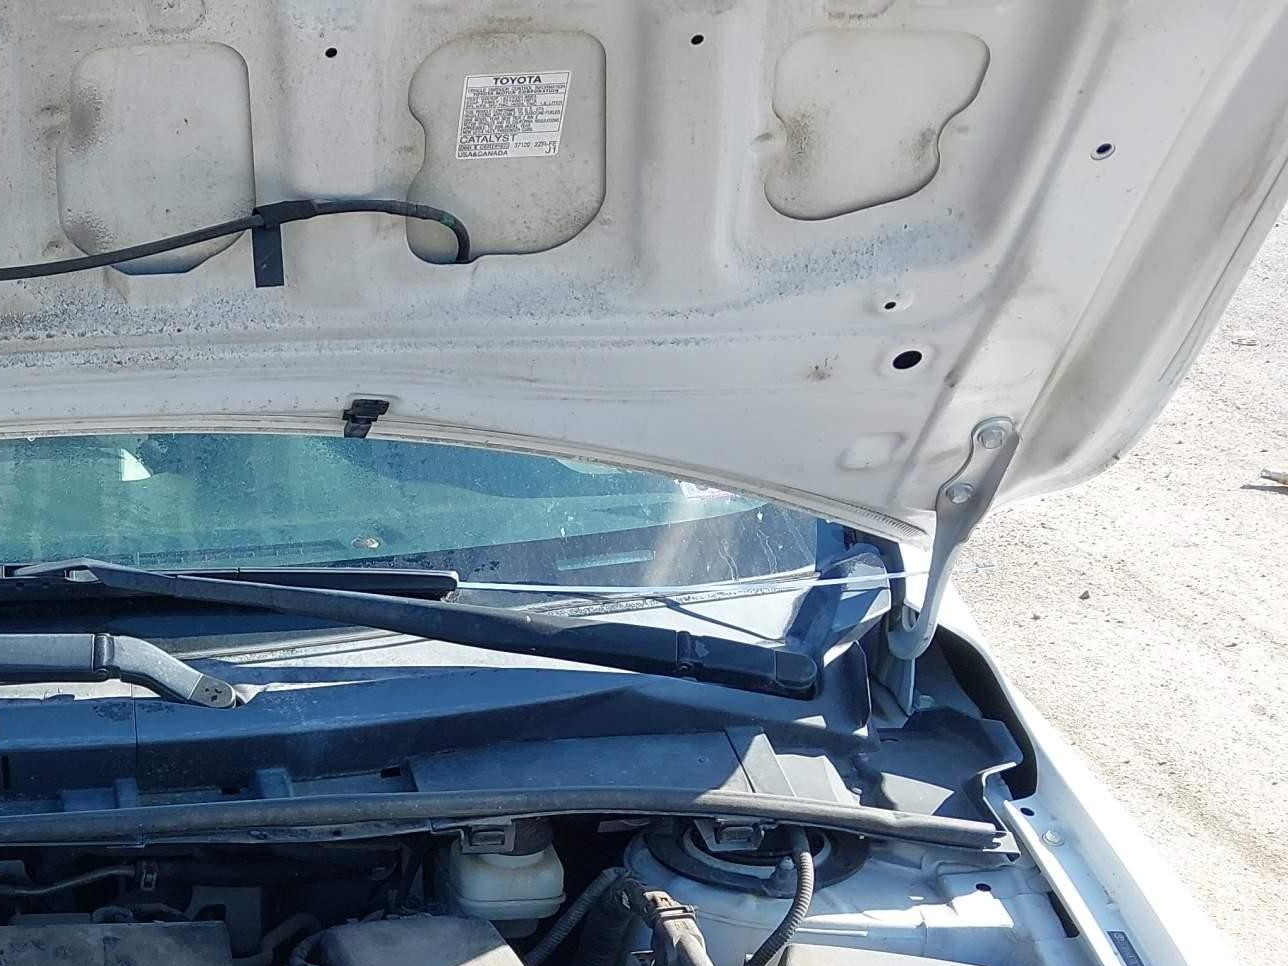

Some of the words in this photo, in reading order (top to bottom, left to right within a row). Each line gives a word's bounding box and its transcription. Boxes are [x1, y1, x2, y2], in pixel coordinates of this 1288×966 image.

[493, 76, 542, 85] TOYOTA
[460, 135, 516, 144] CATALYST
[457, 150, 509, 158] USA&CANADA
[544, 146, 556, 154] J1
